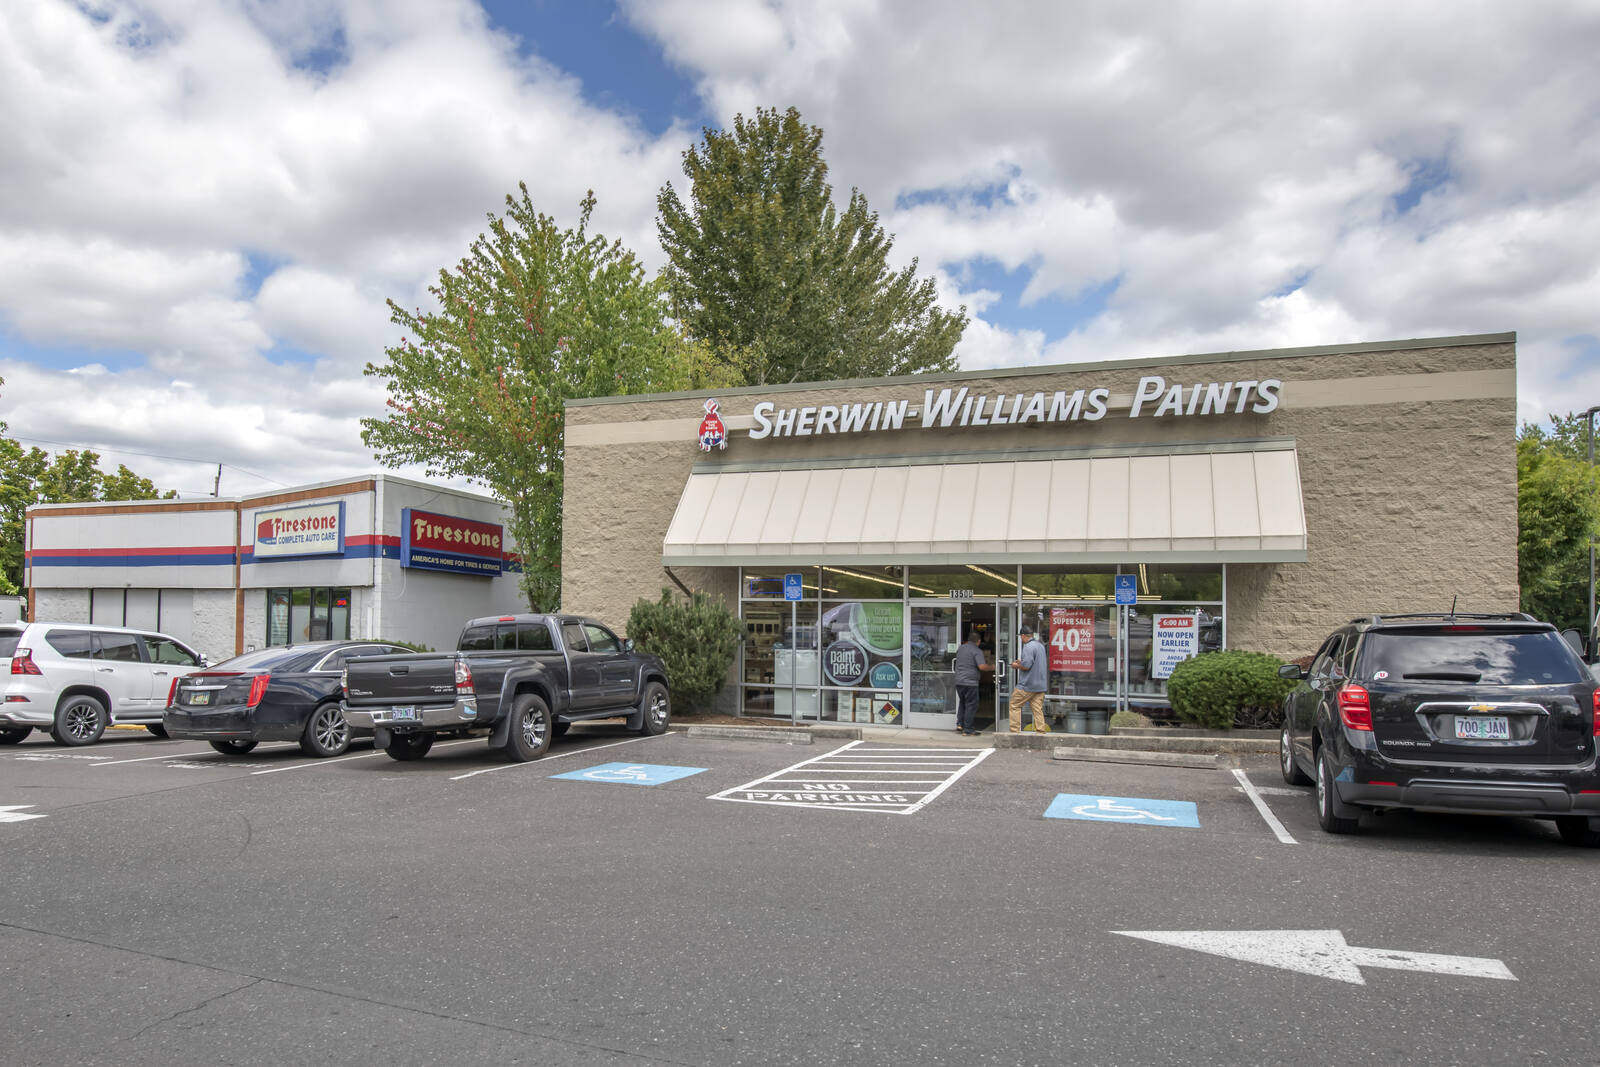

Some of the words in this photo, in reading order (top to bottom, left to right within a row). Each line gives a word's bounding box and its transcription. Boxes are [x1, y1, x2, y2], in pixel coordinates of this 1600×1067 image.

[1129, 376, 1281, 418] PAINTS
[274, 515, 337, 537] Firestone
[278, 534, 305, 545] COMPLETE
[305, 533, 320, 543] AUTO
[321, 531, 336, 541] CARE
[413, 518, 500, 549] Firestone
[411, 555, 439, 564] AMERICA'S
[440, 558, 454, 566] HOME
[949, 589, 974, 598] 13500
[1053, 617, 1075, 625] SUPER
[1157, 631, 1174, 639] NOW
[1175, 631, 1194, 639] OPEN
[1161, 639, 1190, 647] EARLIER
[830, 649, 856, 665] paint
[833, 661, 861, 676] perks
[1457, 720, 1478, 733] 700
[1486, 721, 1506, 734] JAN
[802, 783, 850, 791] NO
[746, 792, 908, 802] PARKING
